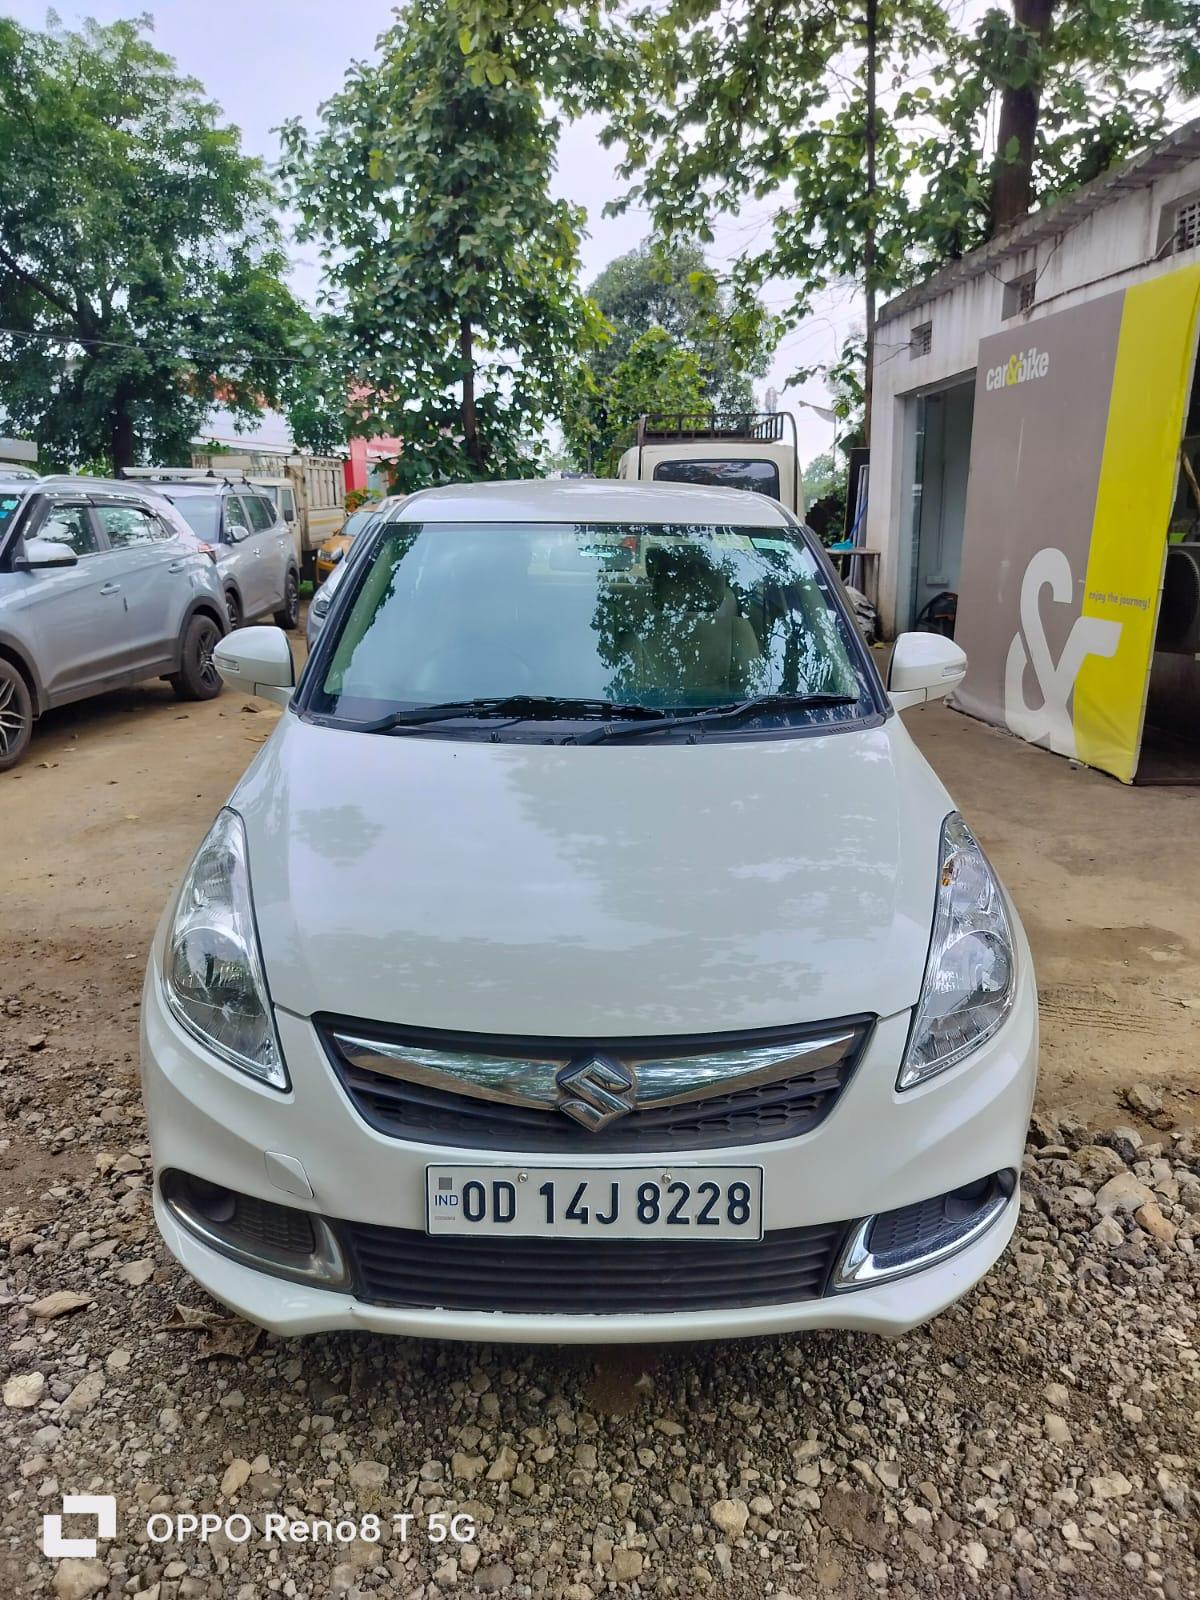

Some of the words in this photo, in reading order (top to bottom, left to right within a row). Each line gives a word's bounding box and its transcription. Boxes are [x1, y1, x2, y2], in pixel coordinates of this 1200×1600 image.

[986, 347, 1049, 391] car&bike
[1088, 592, 1106, 604] enjoy
[1108, 592, 1118, 603] the
[435, 1195, 458, 1206] IND
[462, 1181, 517, 1222] OD
[539, 1182, 619, 1224] 14J
[636, 1182, 751, 1225] 8228
